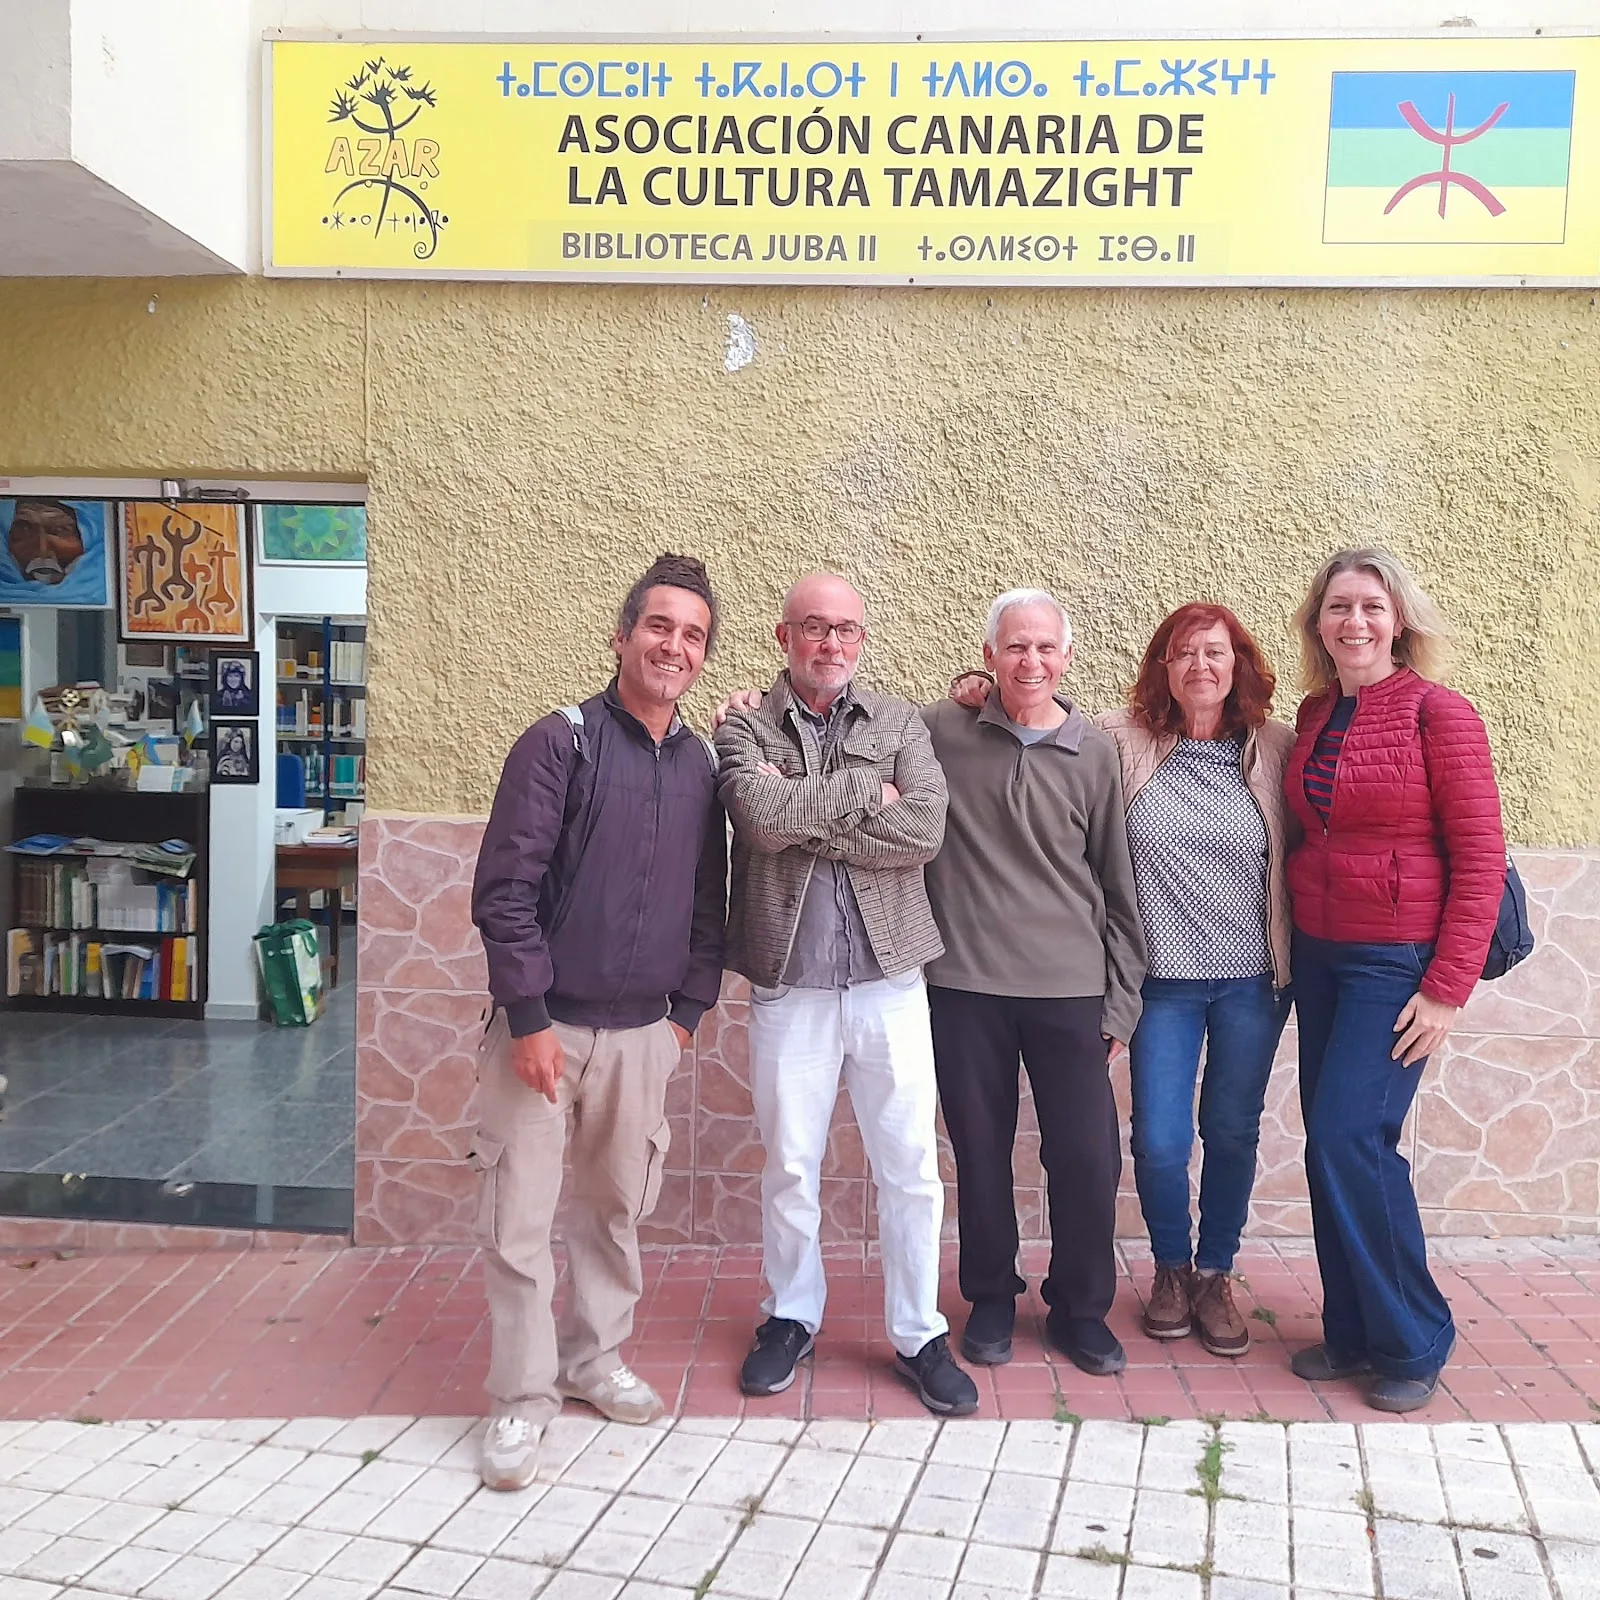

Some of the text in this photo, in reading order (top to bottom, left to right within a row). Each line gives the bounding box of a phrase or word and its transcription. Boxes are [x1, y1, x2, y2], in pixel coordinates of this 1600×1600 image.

[557, 106, 1204, 155] ASOCIACIÓN CANARIA DE
[568, 166, 1193, 207] LA CULTURA TAMAZIGHT
[562, 232, 877, 262] BIBLIOTECA JUBA II
